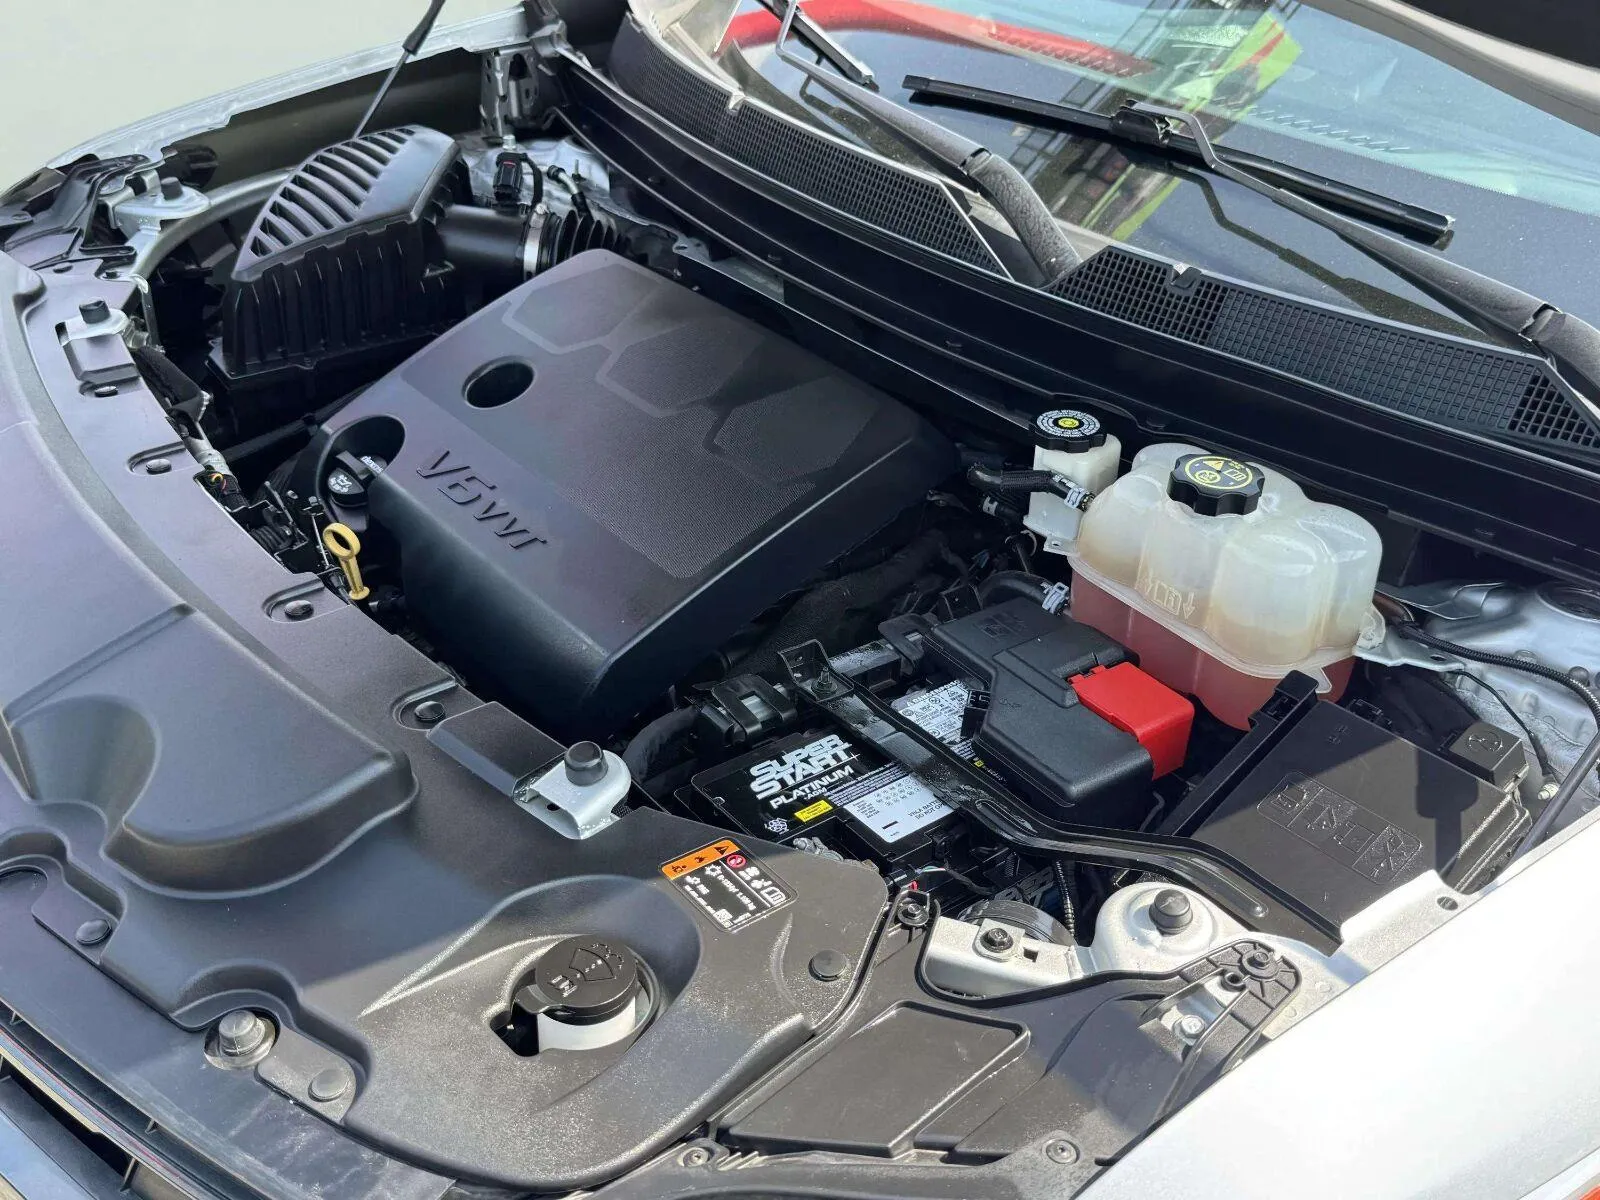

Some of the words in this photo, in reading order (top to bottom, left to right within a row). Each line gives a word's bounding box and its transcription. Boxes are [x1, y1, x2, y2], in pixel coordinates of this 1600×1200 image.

[749, 733, 846, 782] SUPER
[749, 742, 853, 800] START
[769, 765, 855, 810] PLATINUM
